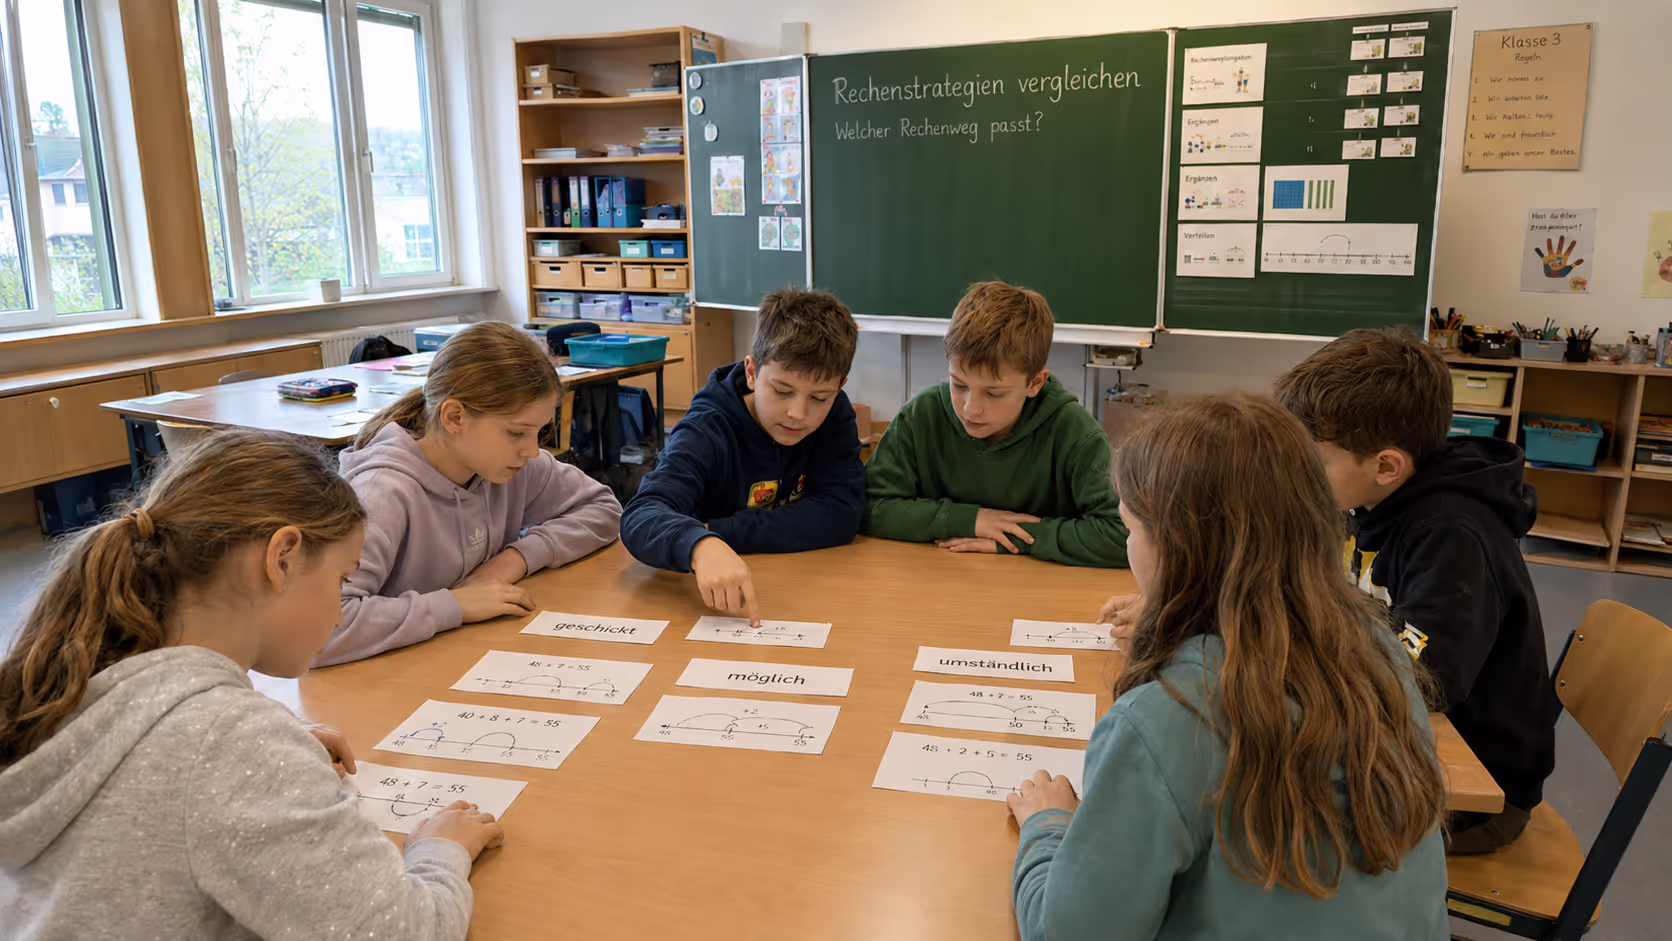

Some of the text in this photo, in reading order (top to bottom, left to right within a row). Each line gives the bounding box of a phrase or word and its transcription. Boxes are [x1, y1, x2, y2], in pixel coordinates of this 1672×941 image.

[1501, 32, 1561, 49] Klasse 3
[1514, 52, 1542, 64] Regeln
[832, 62, 1141, 108] Rechenstrategien vergleichen
[835, 111, 1043, 144] Welcher Rechenweg passt?
[553, 622, 637, 635] geschickt
[939, 658, 1053, 672] umständlich
[728, 672, 806, 685] möglich
[490, 714, 499, 722] 8
[544, 720, 561, 728] 55
[986, 750, 995, 758] 5
[1016, 753, 1032, 761] 55
[380, 777, 398, 787] 48
[418, 781, 428, 789] 7
[448, 784, 468, 794] 55
